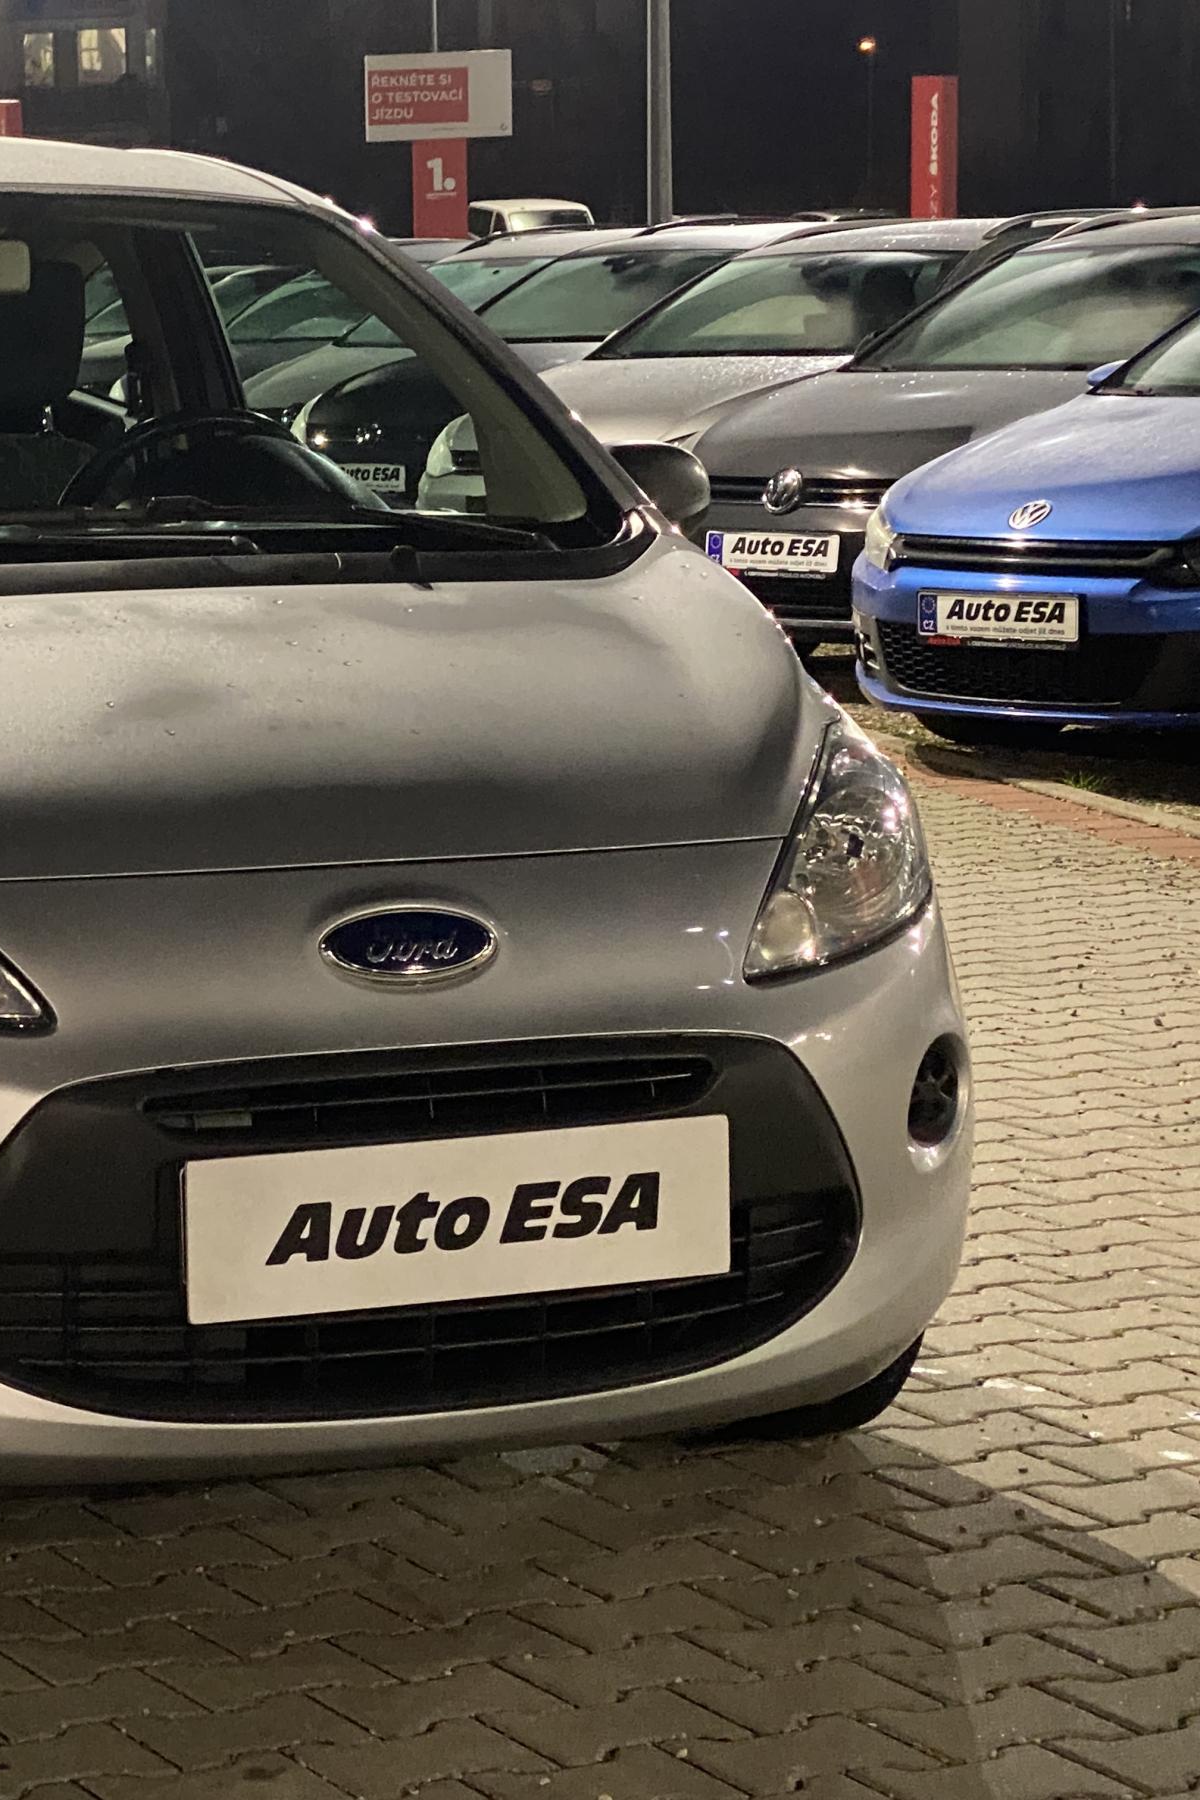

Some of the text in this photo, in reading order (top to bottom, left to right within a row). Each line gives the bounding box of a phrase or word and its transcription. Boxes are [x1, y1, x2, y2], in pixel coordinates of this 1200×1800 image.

[439, 73, 452, 86] SI
[371, 88, 463, 104] O TESTOVACÍ
[372, 106, 414, 120] JÍZDU
[426, 157, 456, 191] 1.
[372, 467, 400, 481] ESA
[730, 537, 830, 557] Auto ESA
[946, 599, 1066, 624] Auto ESA
[922, 620, 935, 631] CZ
[366, 929, 459, 964] Ford
[265, 1171, 661, 1266] Auto ESA
